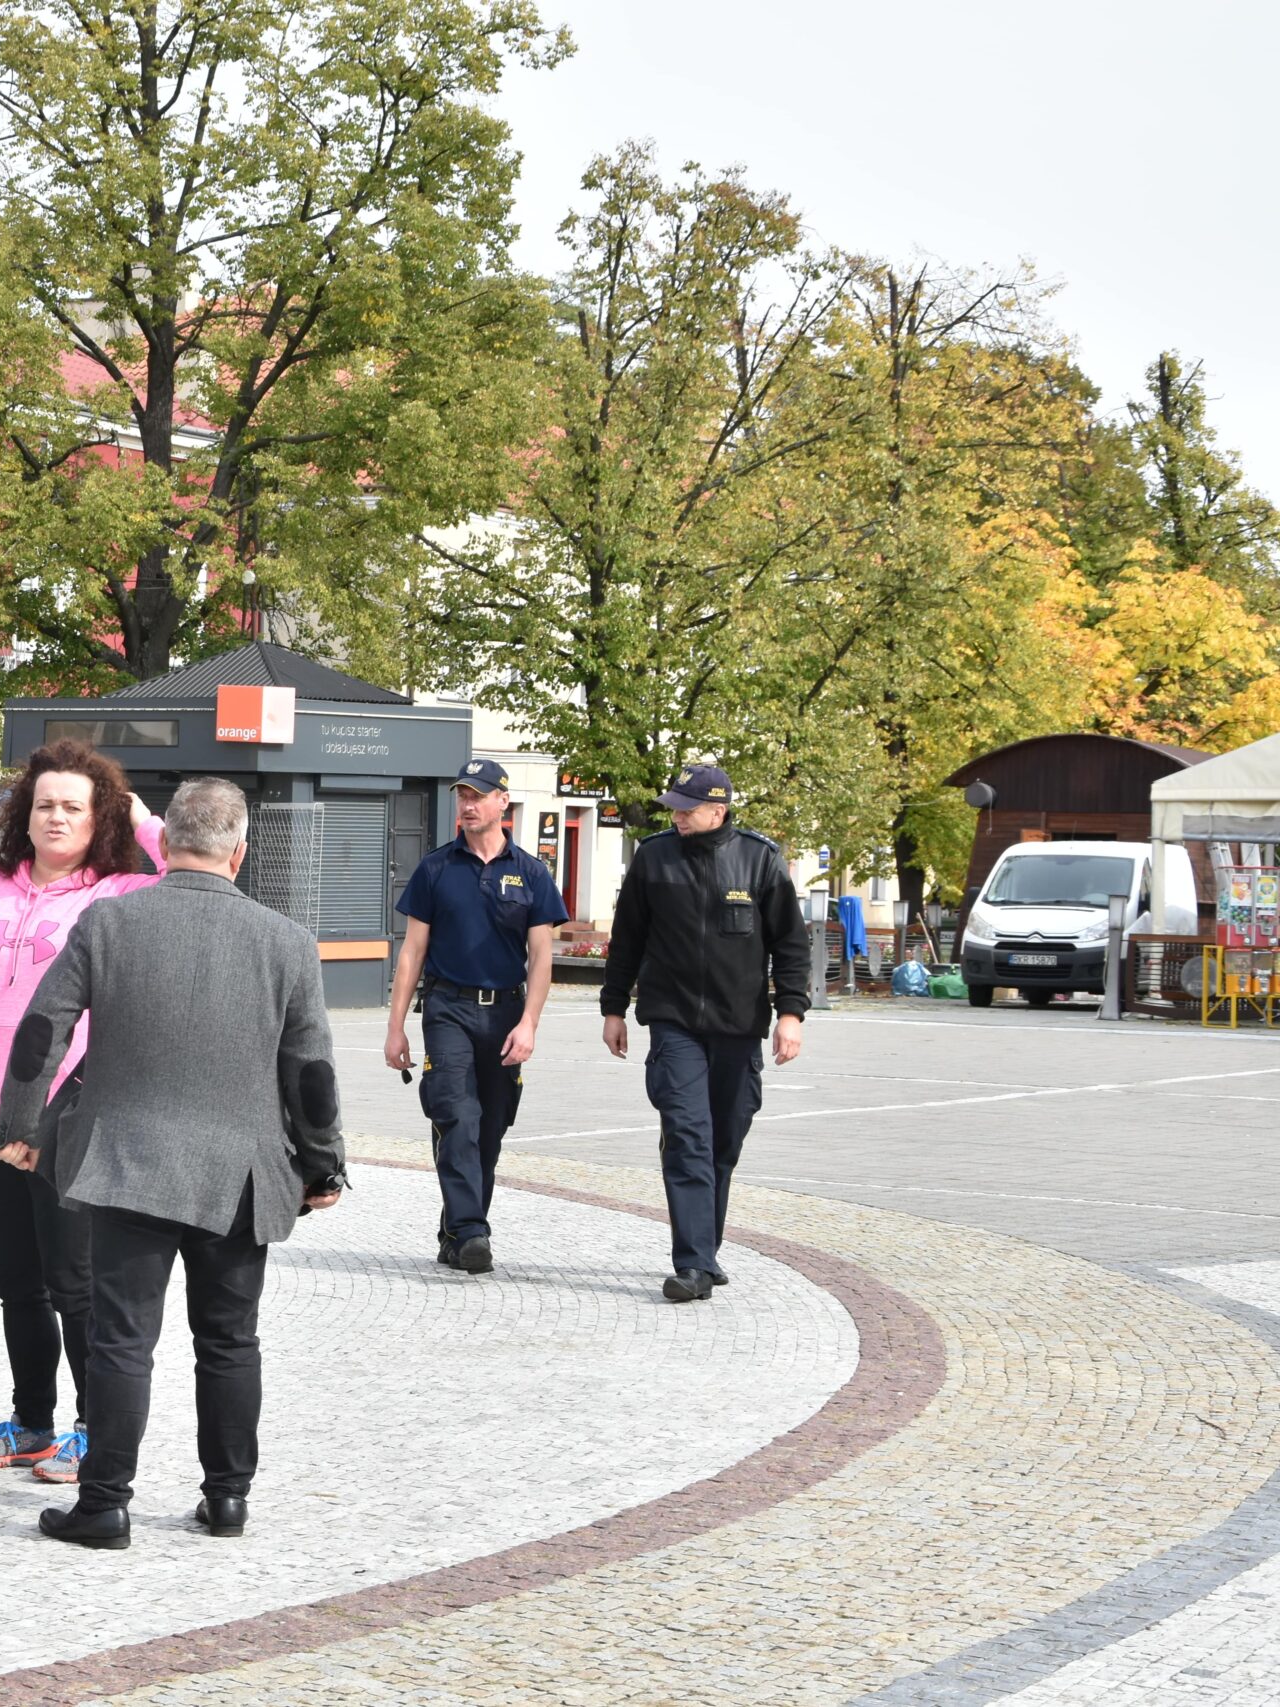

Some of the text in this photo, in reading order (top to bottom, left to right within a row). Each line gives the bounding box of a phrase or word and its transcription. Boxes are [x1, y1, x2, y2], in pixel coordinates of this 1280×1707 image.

[217, 728, 257, 740] orange
[357, 726, 381, 737] starter
[367, 744, 389, 755] konto
